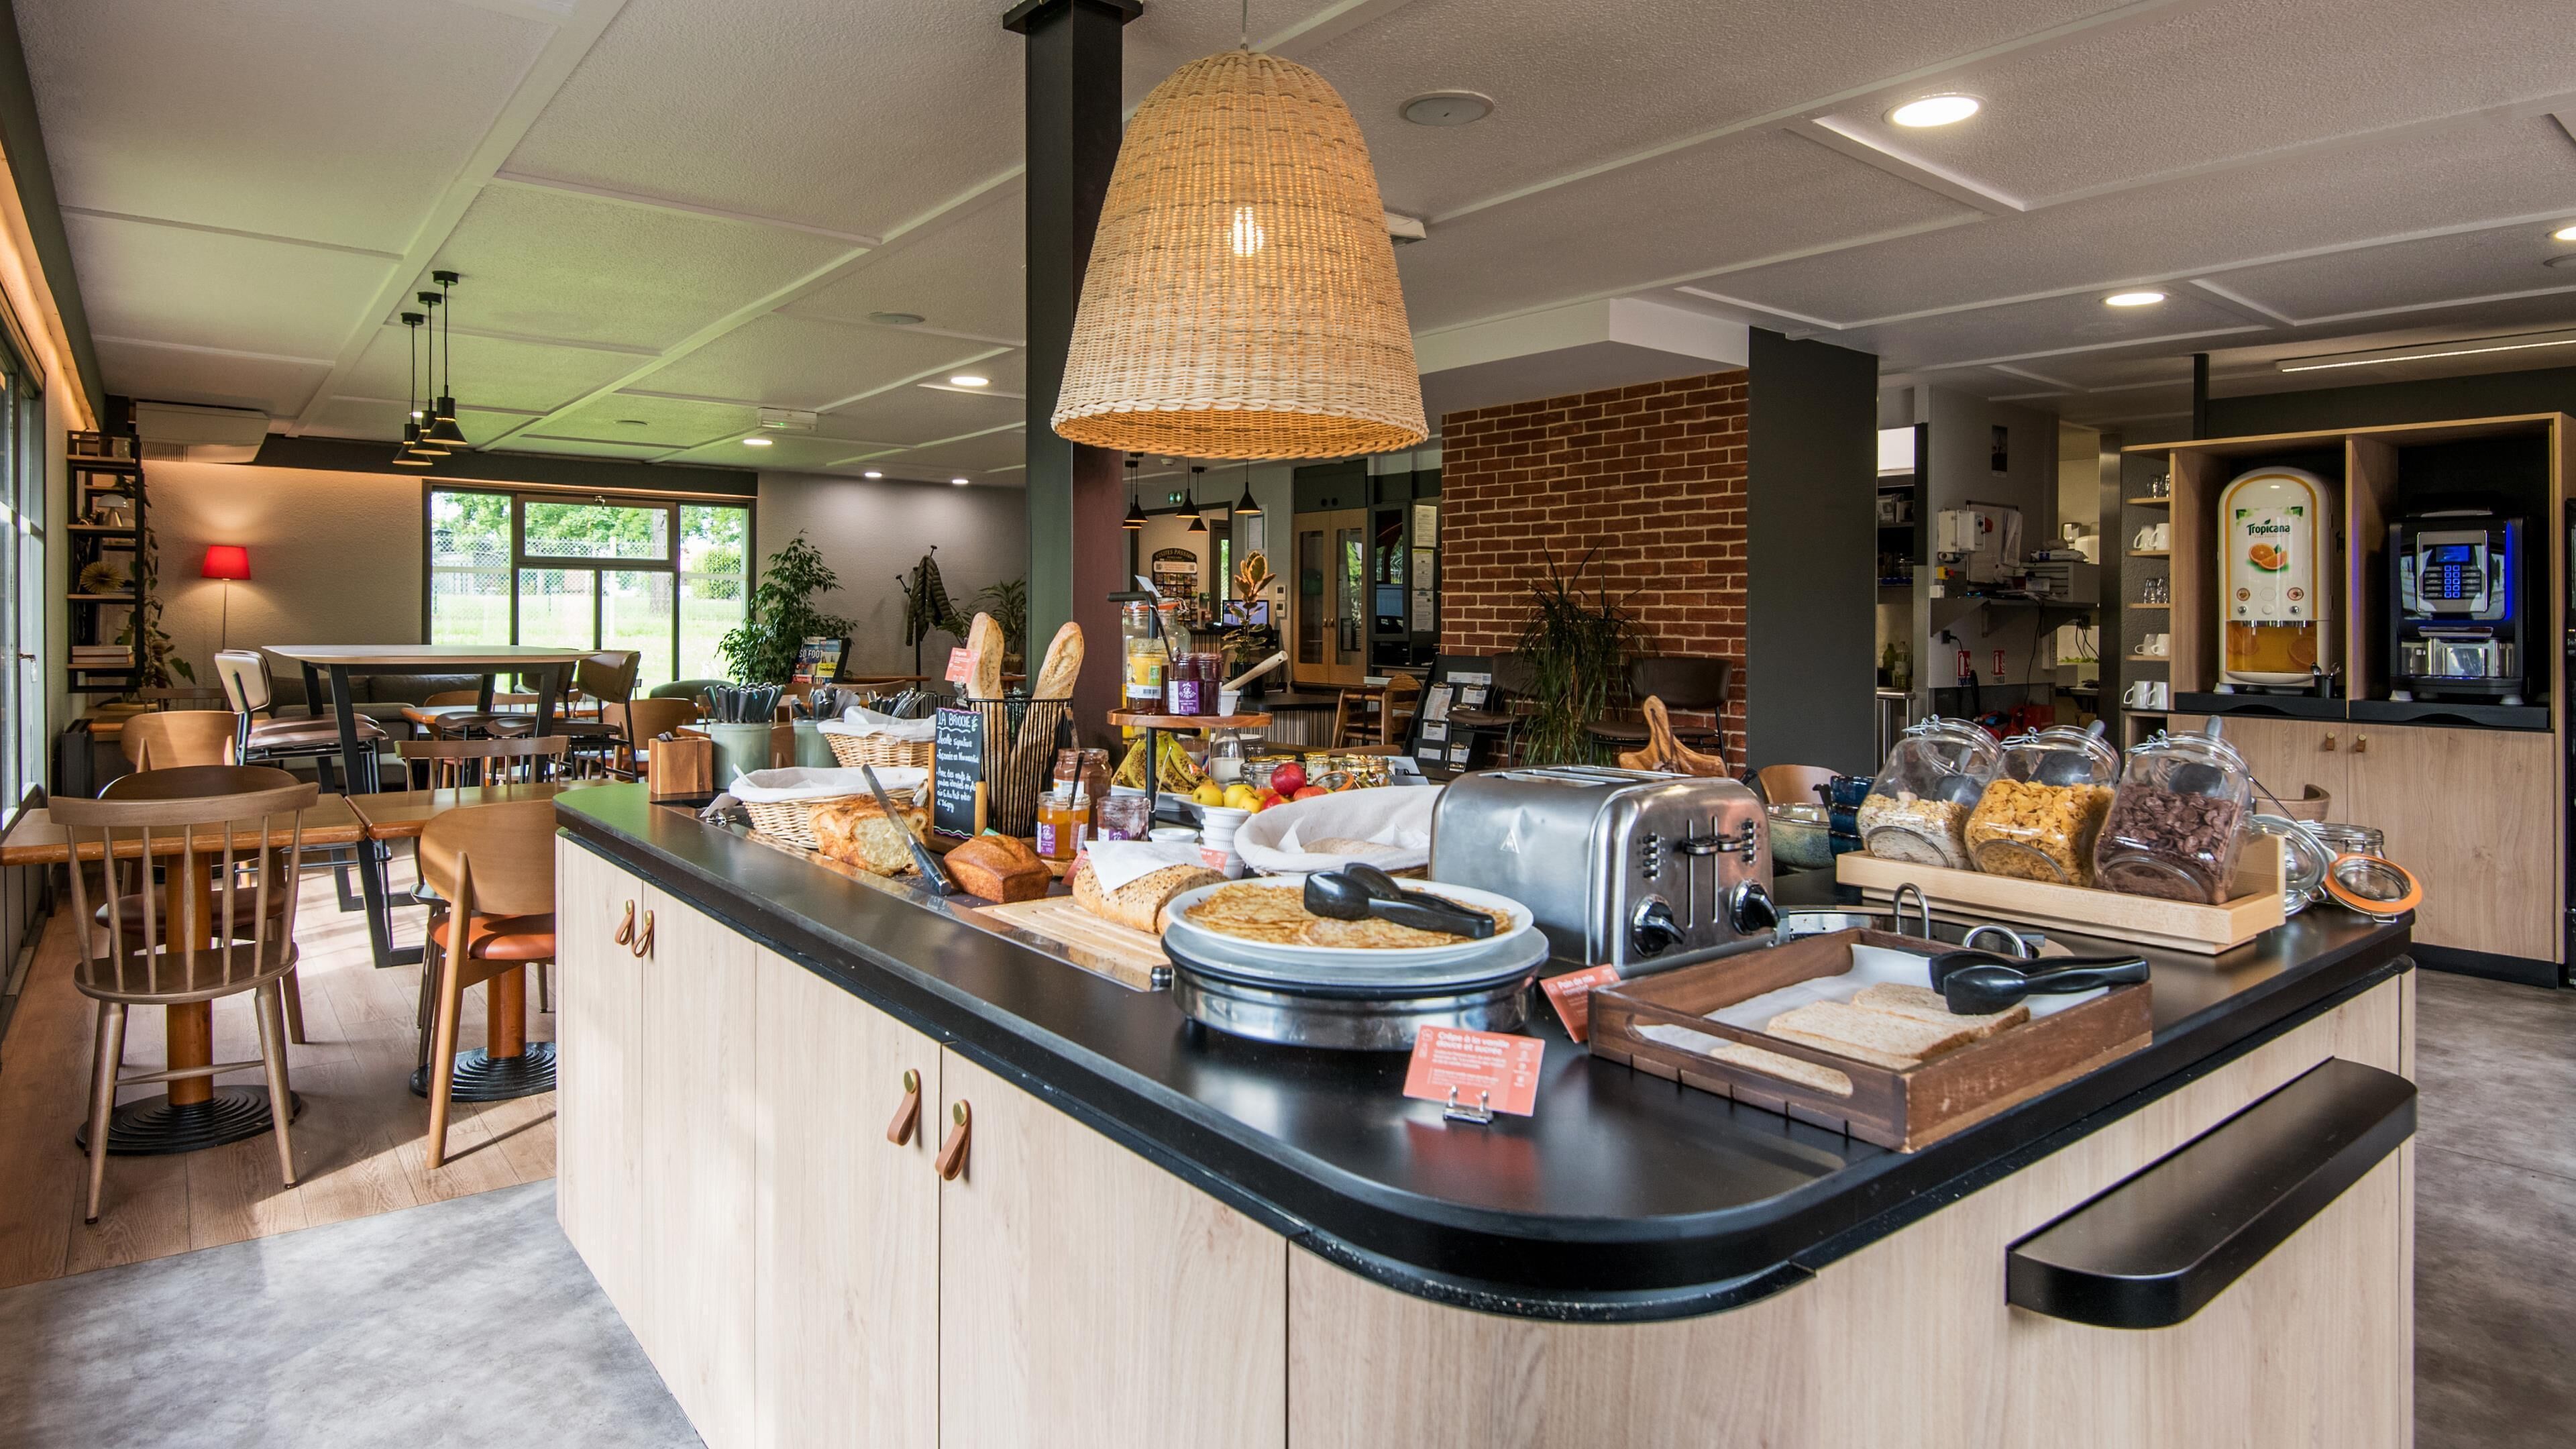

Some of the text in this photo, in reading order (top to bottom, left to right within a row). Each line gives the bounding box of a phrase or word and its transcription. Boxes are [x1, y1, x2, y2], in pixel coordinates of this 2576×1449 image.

[2247, 519, 2290, 535] Tropicana
[799, 649, 807, 658] SO
[938, 709, 947, 726] LA
[1557, 974, 1596, 990] Pain de mie
[1438, 1031, 1463, 1043] Crêpe
[1464, 1034, 1471, 1043] à
[1471, 1035, 1481, 1044] la
